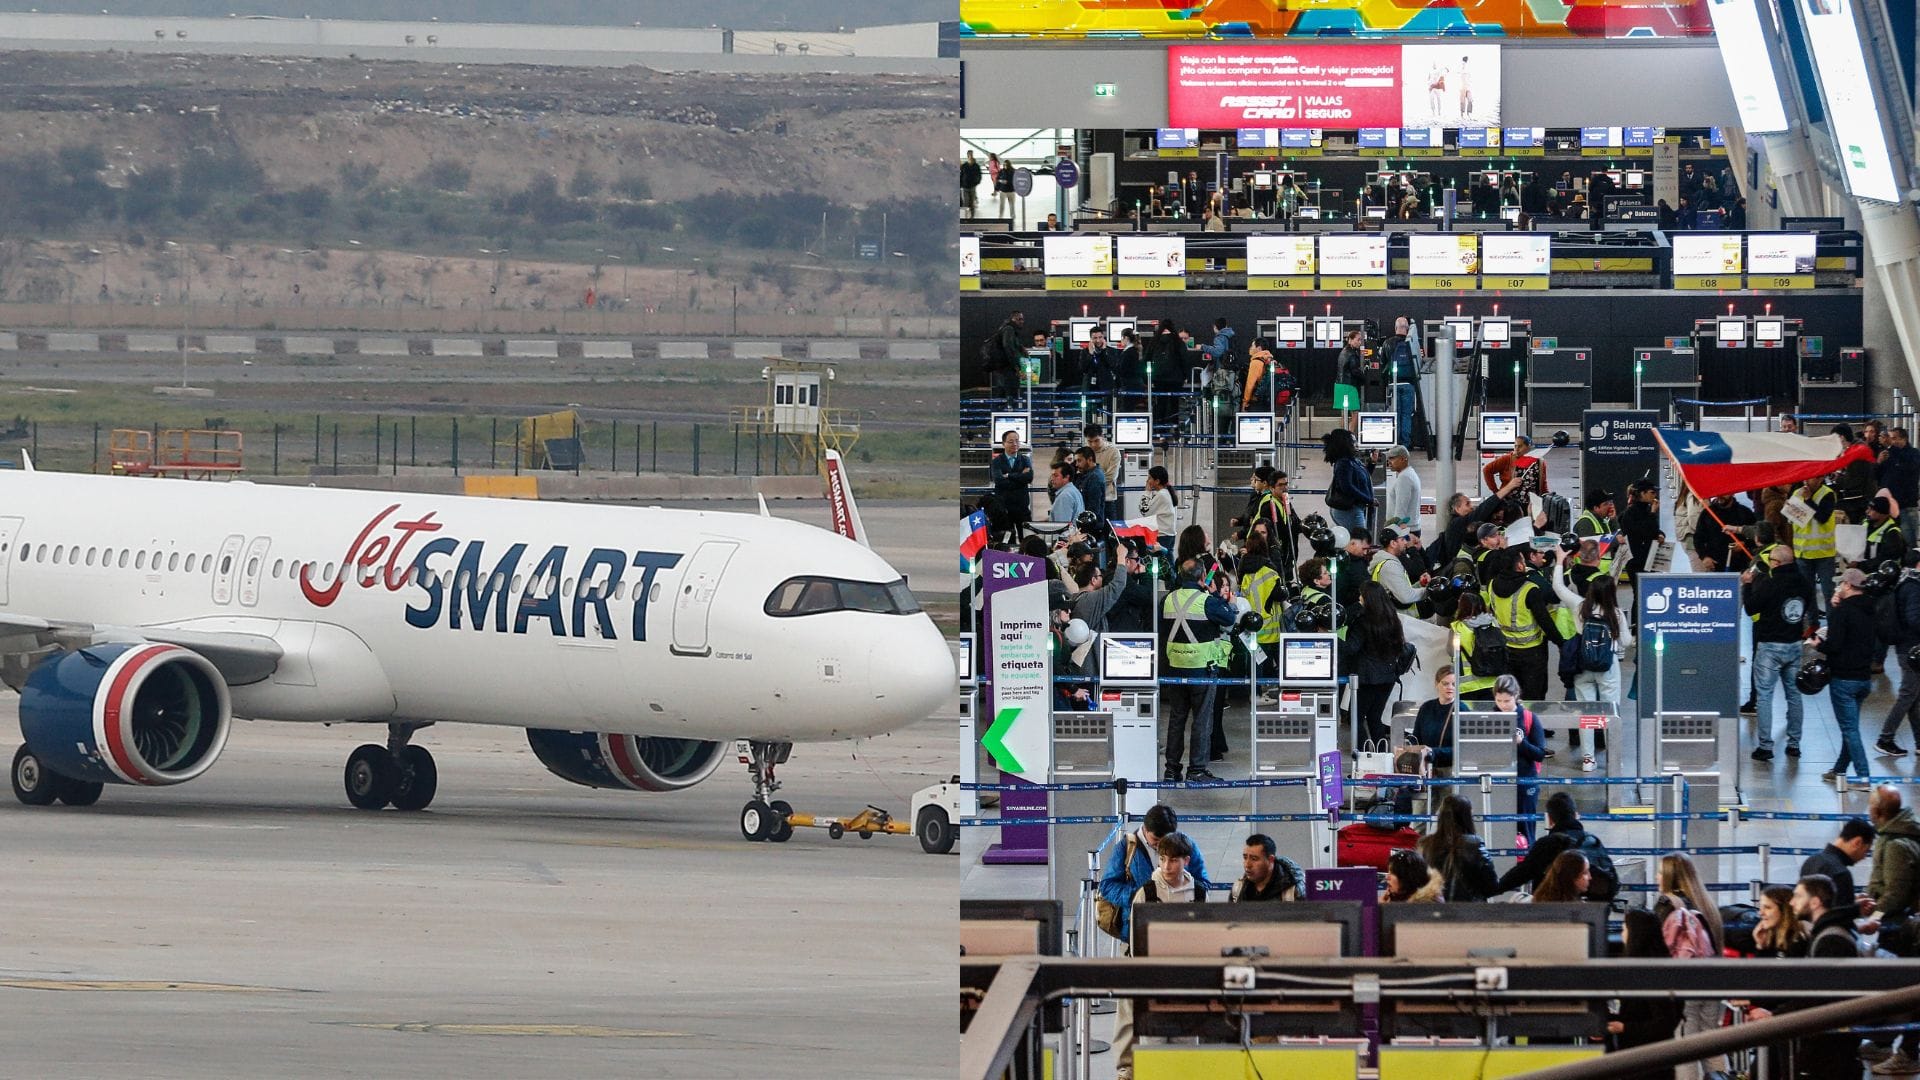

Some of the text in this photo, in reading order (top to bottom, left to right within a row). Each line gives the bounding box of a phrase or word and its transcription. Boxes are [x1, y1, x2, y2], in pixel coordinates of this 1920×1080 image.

[1305, 96, 1342, 105] VIAJAS
[1305, 109, 1351, 118] SEGURO
[1072, 280, 1088, 288] E02
[1144, 280, 1160, 288] E03
[1273, 280, 1289, 288] E04
[1774, 279, 1790, 287] E09
[1613, 420, 1652, 429] Balanza
[1613, 432, 1635, 440] Scale
[992, 562, 1035, 578] SKY
[1678, 586, 1733, 599] Balanza
[1678, 603, 1708, 614] Scale
[1000, 620, 1042, 631] Imprime
[1000, 631, 1022, 641] aquí
[1001, 660, 1044, 670] etiqueta
